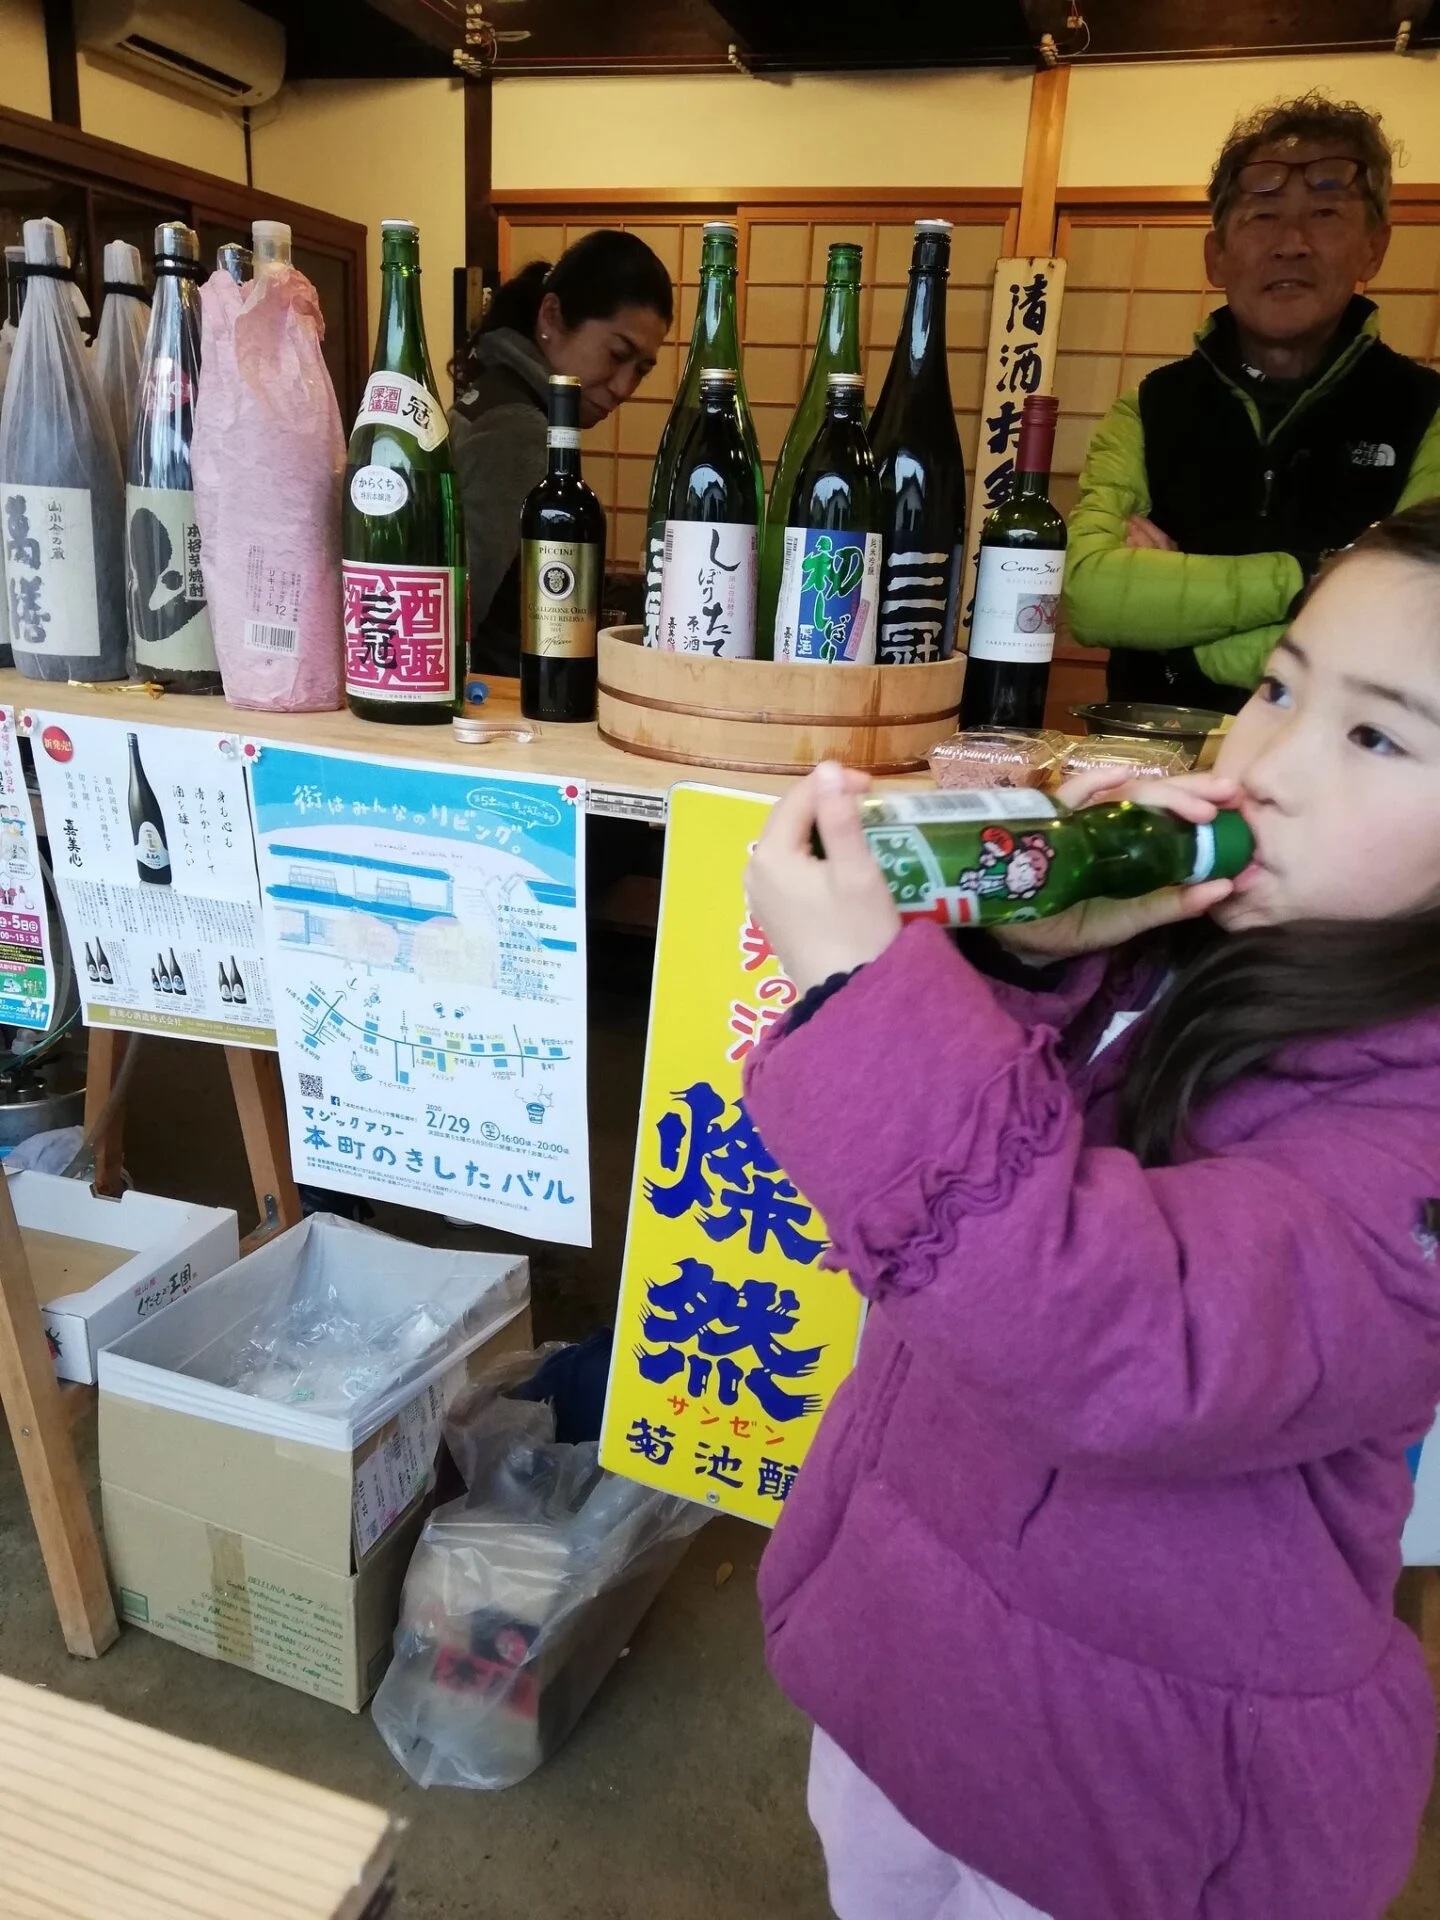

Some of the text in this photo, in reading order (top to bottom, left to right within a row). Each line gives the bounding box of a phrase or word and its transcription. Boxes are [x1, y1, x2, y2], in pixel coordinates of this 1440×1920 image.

[358, 477, 395, 490] からくち
[1001, 560, 1061, 575] Cono Sur
[275, 604, 287, 616] 12
[360, 594, 398, 669] 三冠
[684, 615, 699, 651] 原酒
[292, 784, 521, 855] 街はみんなのリビング。
[63, 818, 83, 868] 嘉美心
[302, 1105, 404, 1137] マジックアワー
[425, 1110, 470, 1134] 2/29
[426, 1103, 442, 1112] 2020
[303, 1124, 575, 1204] 本町のきしたバル
[667, 1395, 785, 1446] サンゼン
